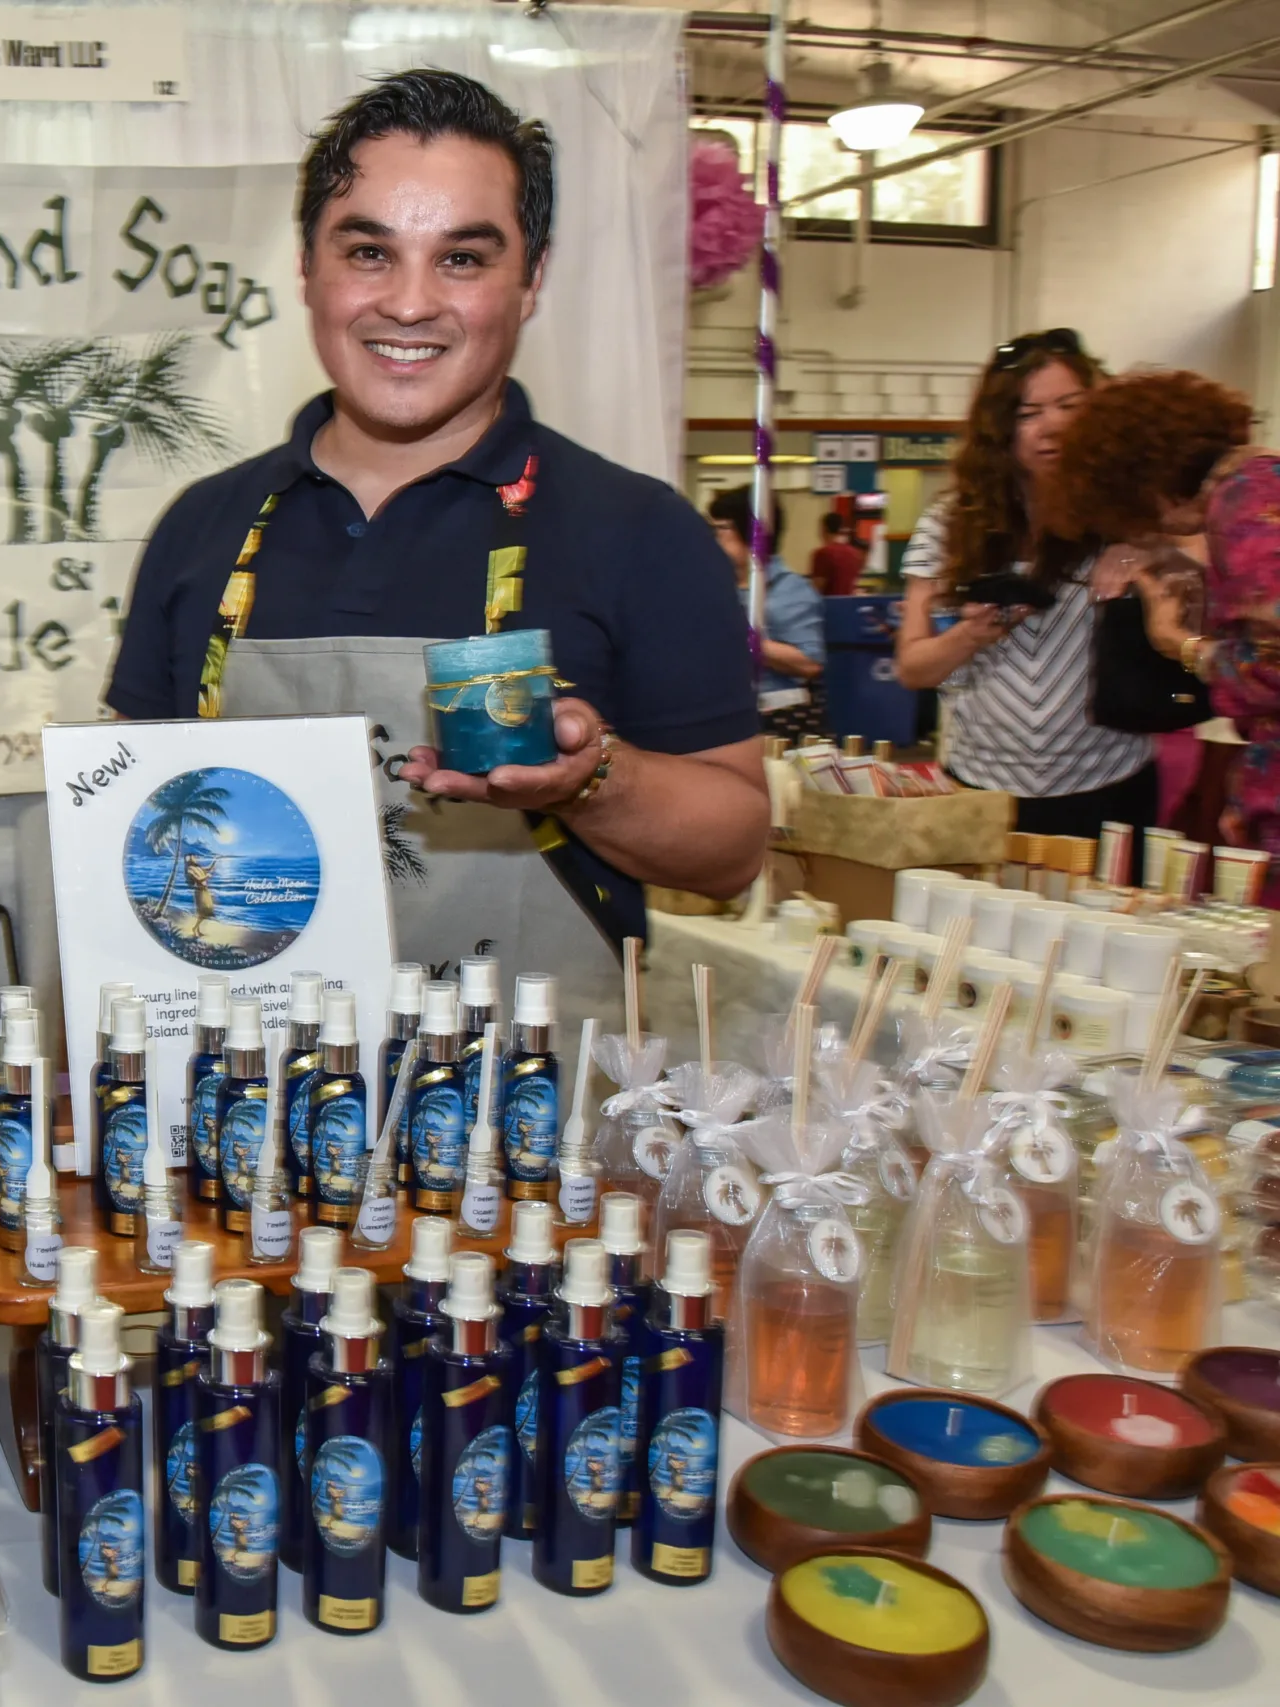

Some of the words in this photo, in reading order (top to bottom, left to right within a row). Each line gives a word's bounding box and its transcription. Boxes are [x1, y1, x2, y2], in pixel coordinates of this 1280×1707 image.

[66, 41, 109, 68] LLC
[113, 196, 276, 350] Soap
[49, 556, 92, 592] &
[65, 740, 136, 807] New!
[245, 889, 308, 905] Collection
[174, 989, 197, 1001] line
[249, 982, 276, 995] with
